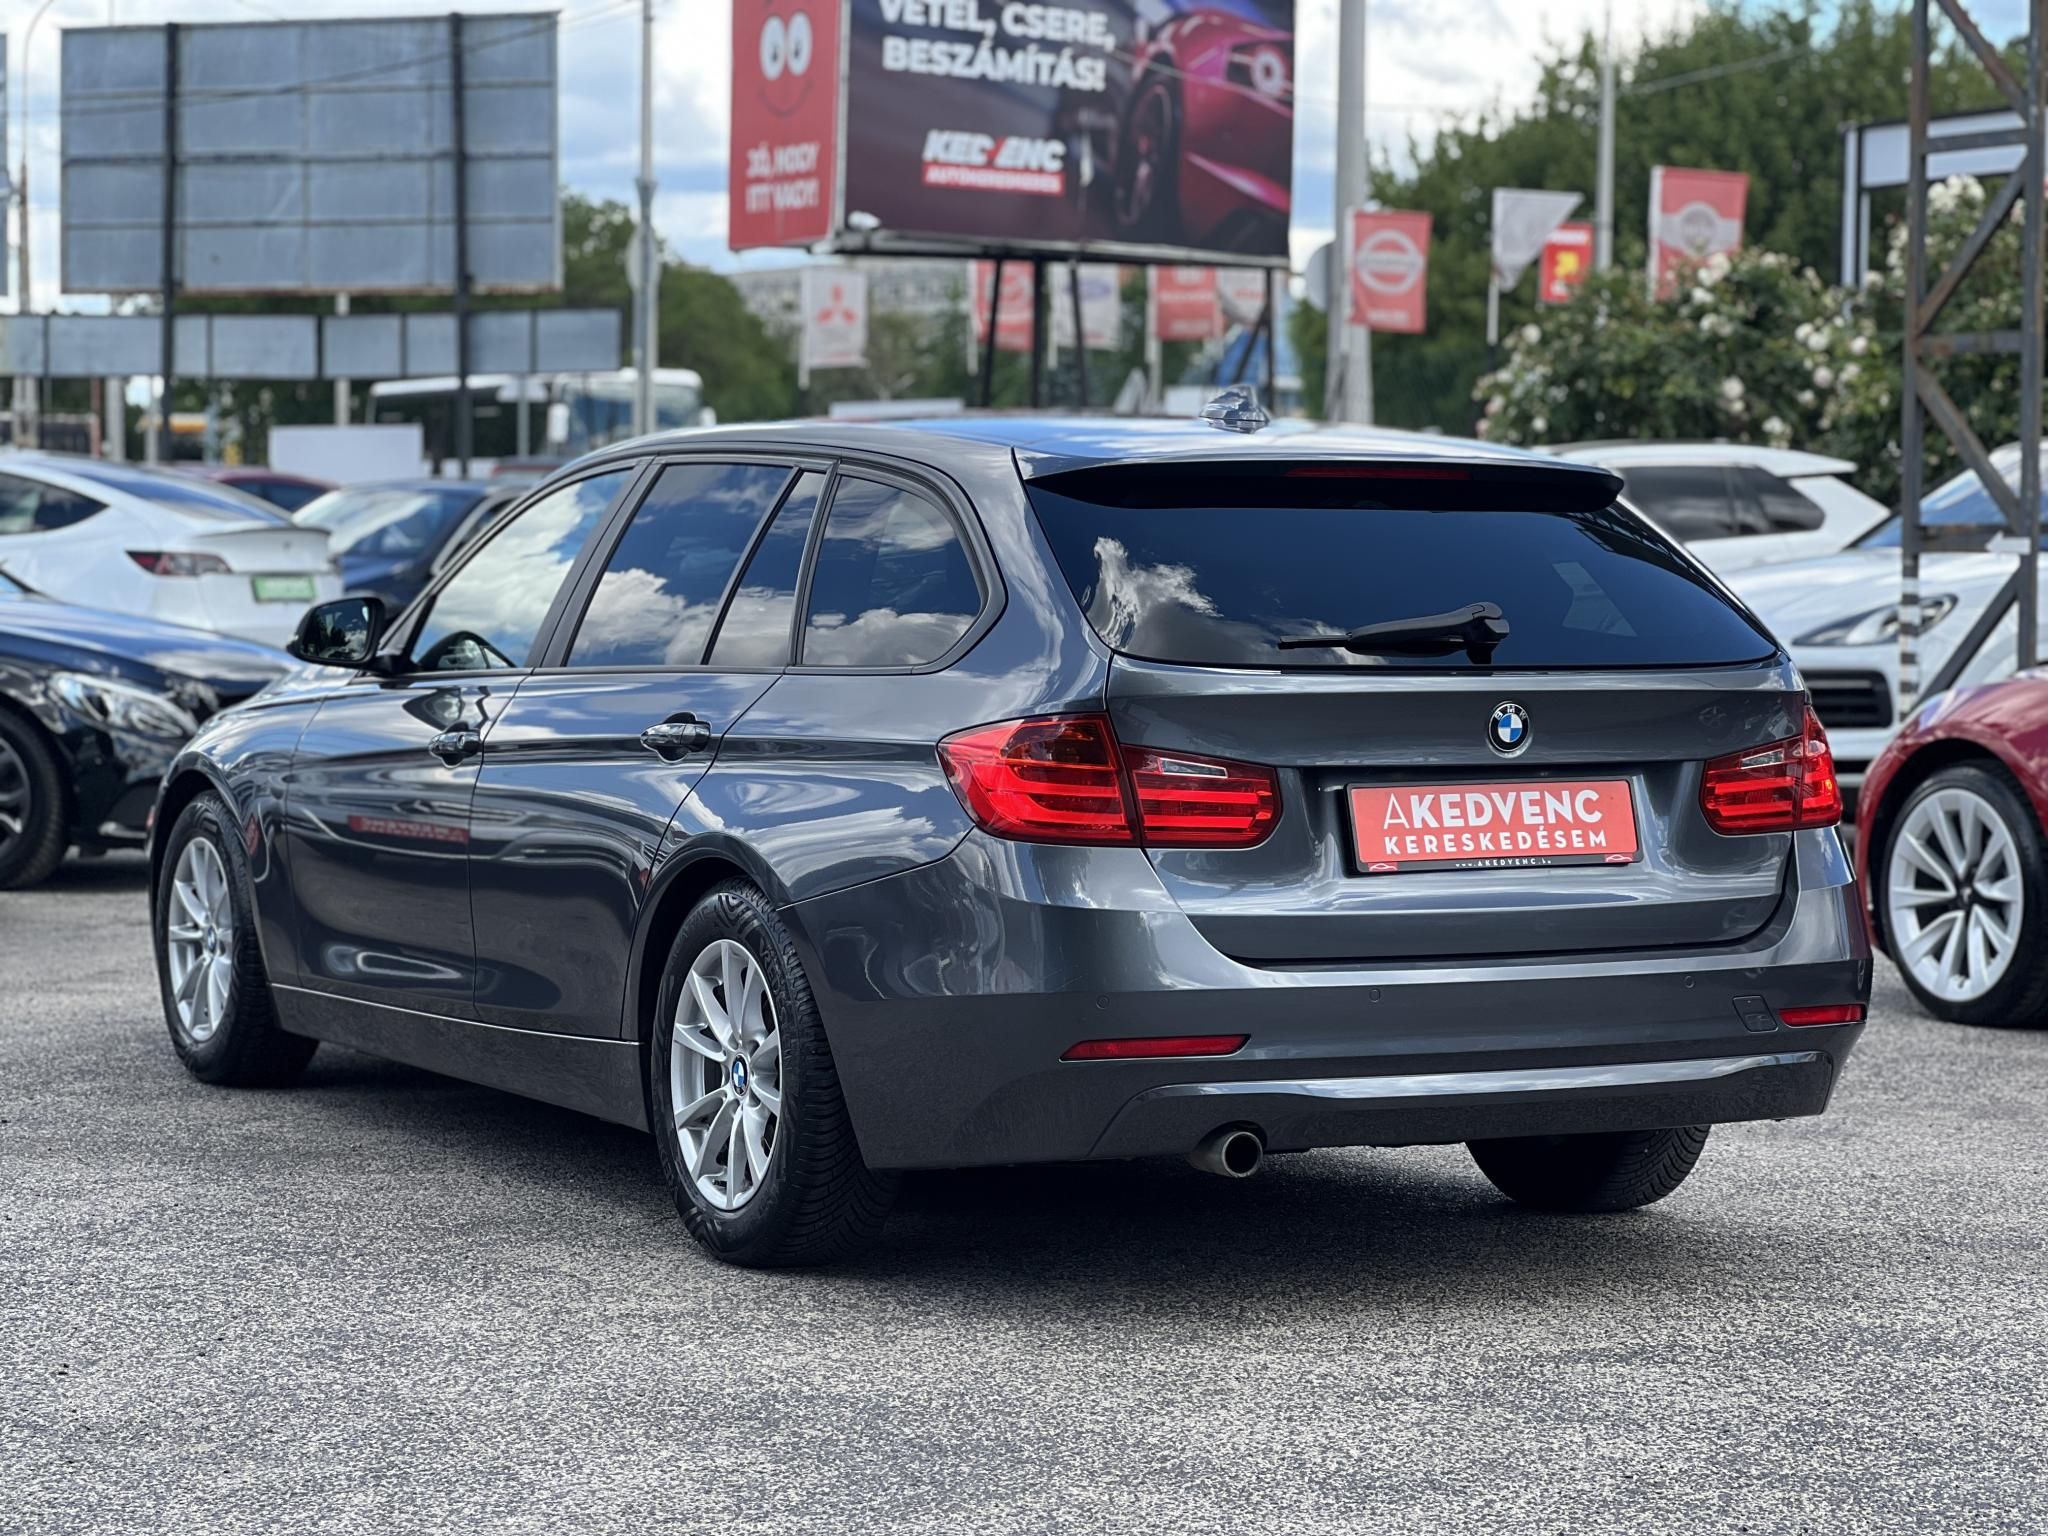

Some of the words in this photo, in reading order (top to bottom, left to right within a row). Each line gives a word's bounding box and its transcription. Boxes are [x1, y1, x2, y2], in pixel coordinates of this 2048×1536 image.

[1001, 3, 1116, 52] CSERE,
[882, 35, 1107, 91] BESZÁMÍTÁS!
[1494, 705, 1527, 720] BMW
[1384, 826, 1607, 855] KERESKEDÉSEM
